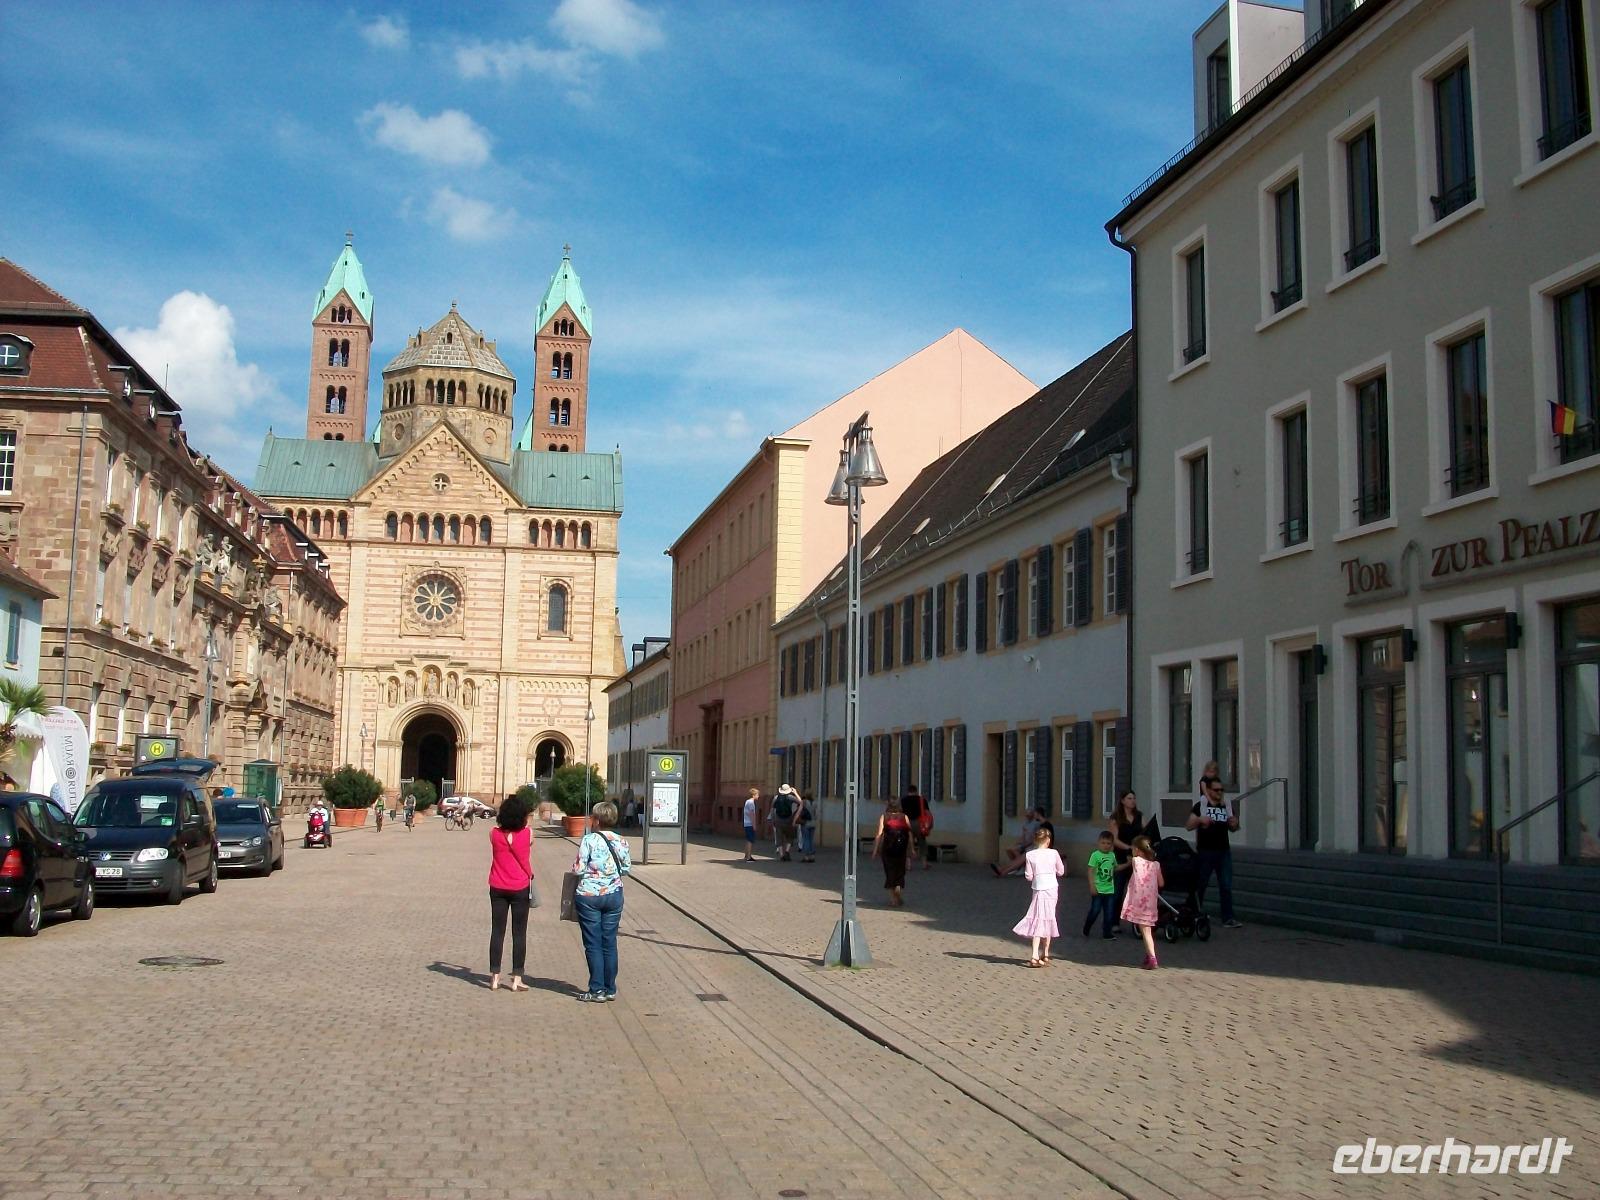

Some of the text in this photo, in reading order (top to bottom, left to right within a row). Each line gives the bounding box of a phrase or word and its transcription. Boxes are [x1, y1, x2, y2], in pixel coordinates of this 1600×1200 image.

[1340, 508, 1600, 597] TOR ZUR PFALZ
[153, 745, 161, 753] H
